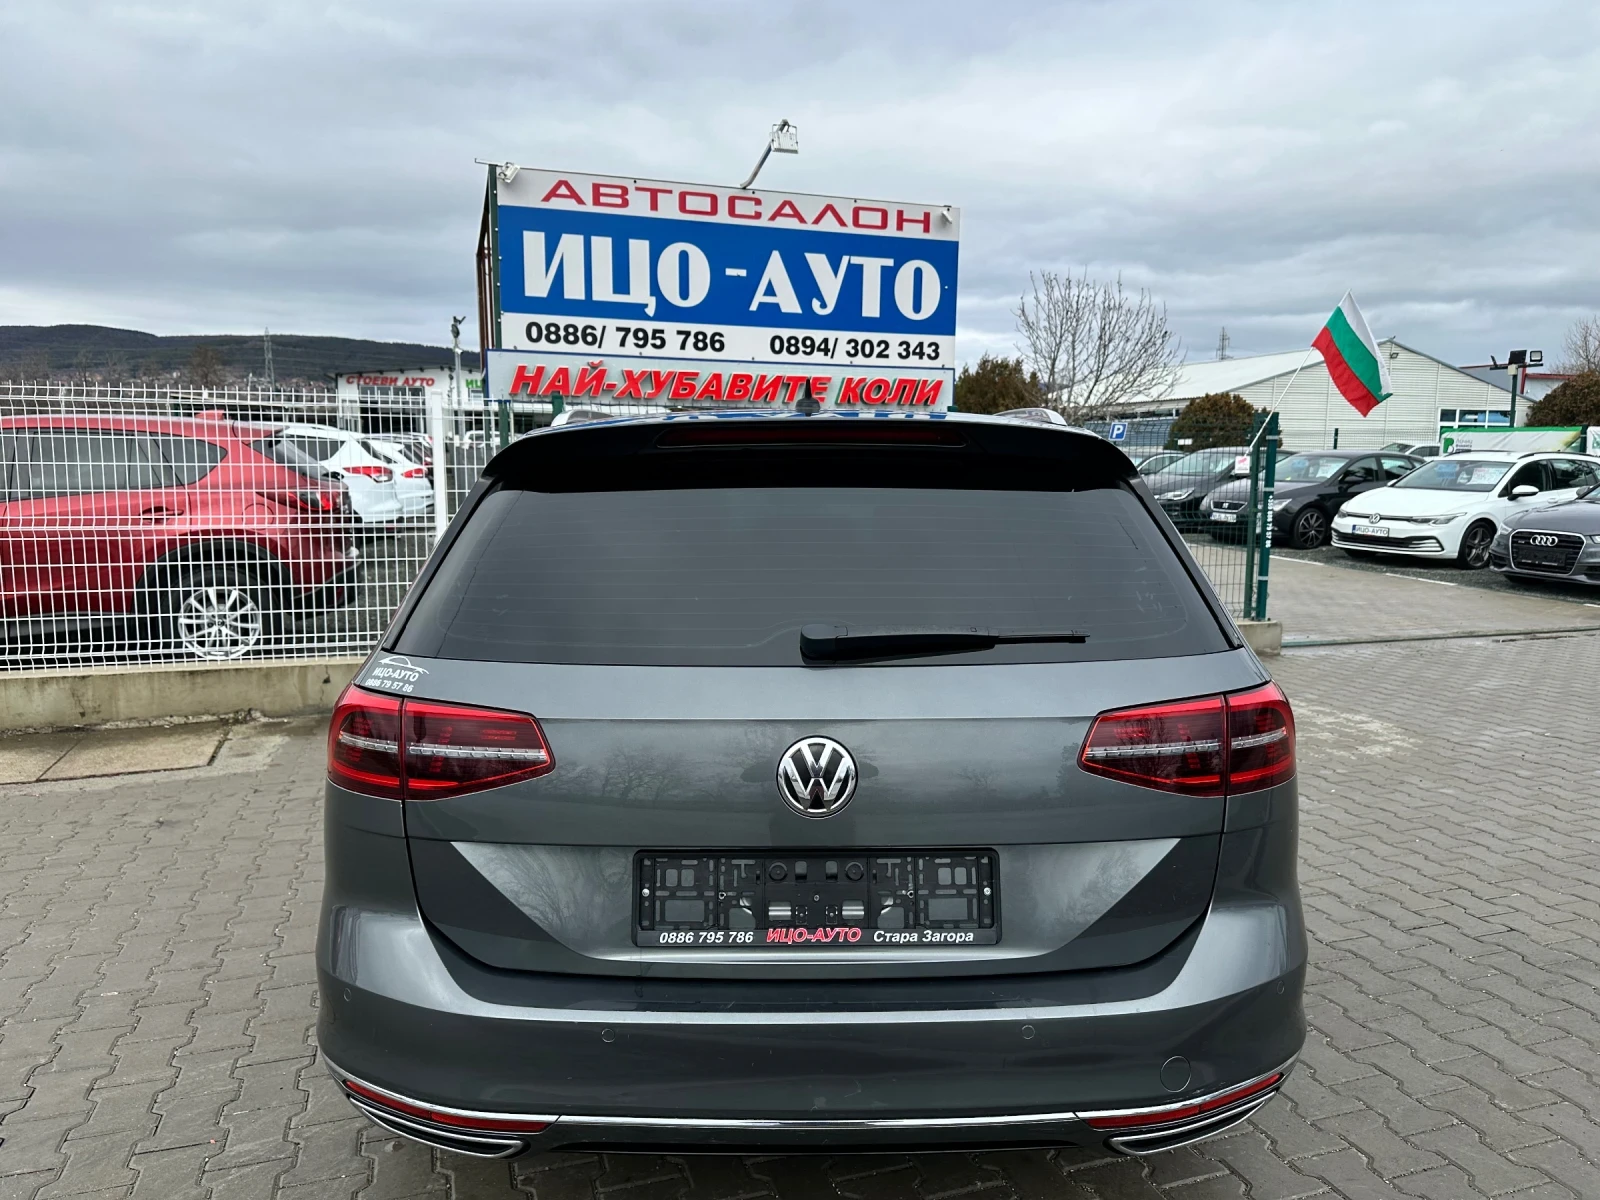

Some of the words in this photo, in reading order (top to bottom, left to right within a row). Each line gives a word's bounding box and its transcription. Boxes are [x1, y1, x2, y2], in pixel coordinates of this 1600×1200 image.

[541, 179, 930, 234] АВТОСАЛОН
[525, 321, 607, 348] 0886/
[615, 327, 666, 349] 795
[676, 330, 725, 352] 786
[769, 335, 839, 359] 0894/
[845, 338, 890, 359] 302
[897, 340, 940, 361] 343
[346, 375, 399, 386] СТОЕВИ
[401, 377, 435, 387] АУТО
[508, 360, 832, 404] НАЙ-ХУБАВИТЕ
[837, 376, 943, 405] КОЛИ
[1112, 424, 1124, 439] P
[372, 667, 419, 681] ИЦО-АУТО
[382, 680, 391, 688] 79
[391, 682, 403, 690] 57
[659, 931, 695, 943] 0886
[699, 931, 725, 943] 795
[728, 931, 754, 943] 786
[766, 927, 862, 944] ИЦО-АУТО
[873, 930, 918, 943] Стара
[922, 930, 974, 943] Загора
